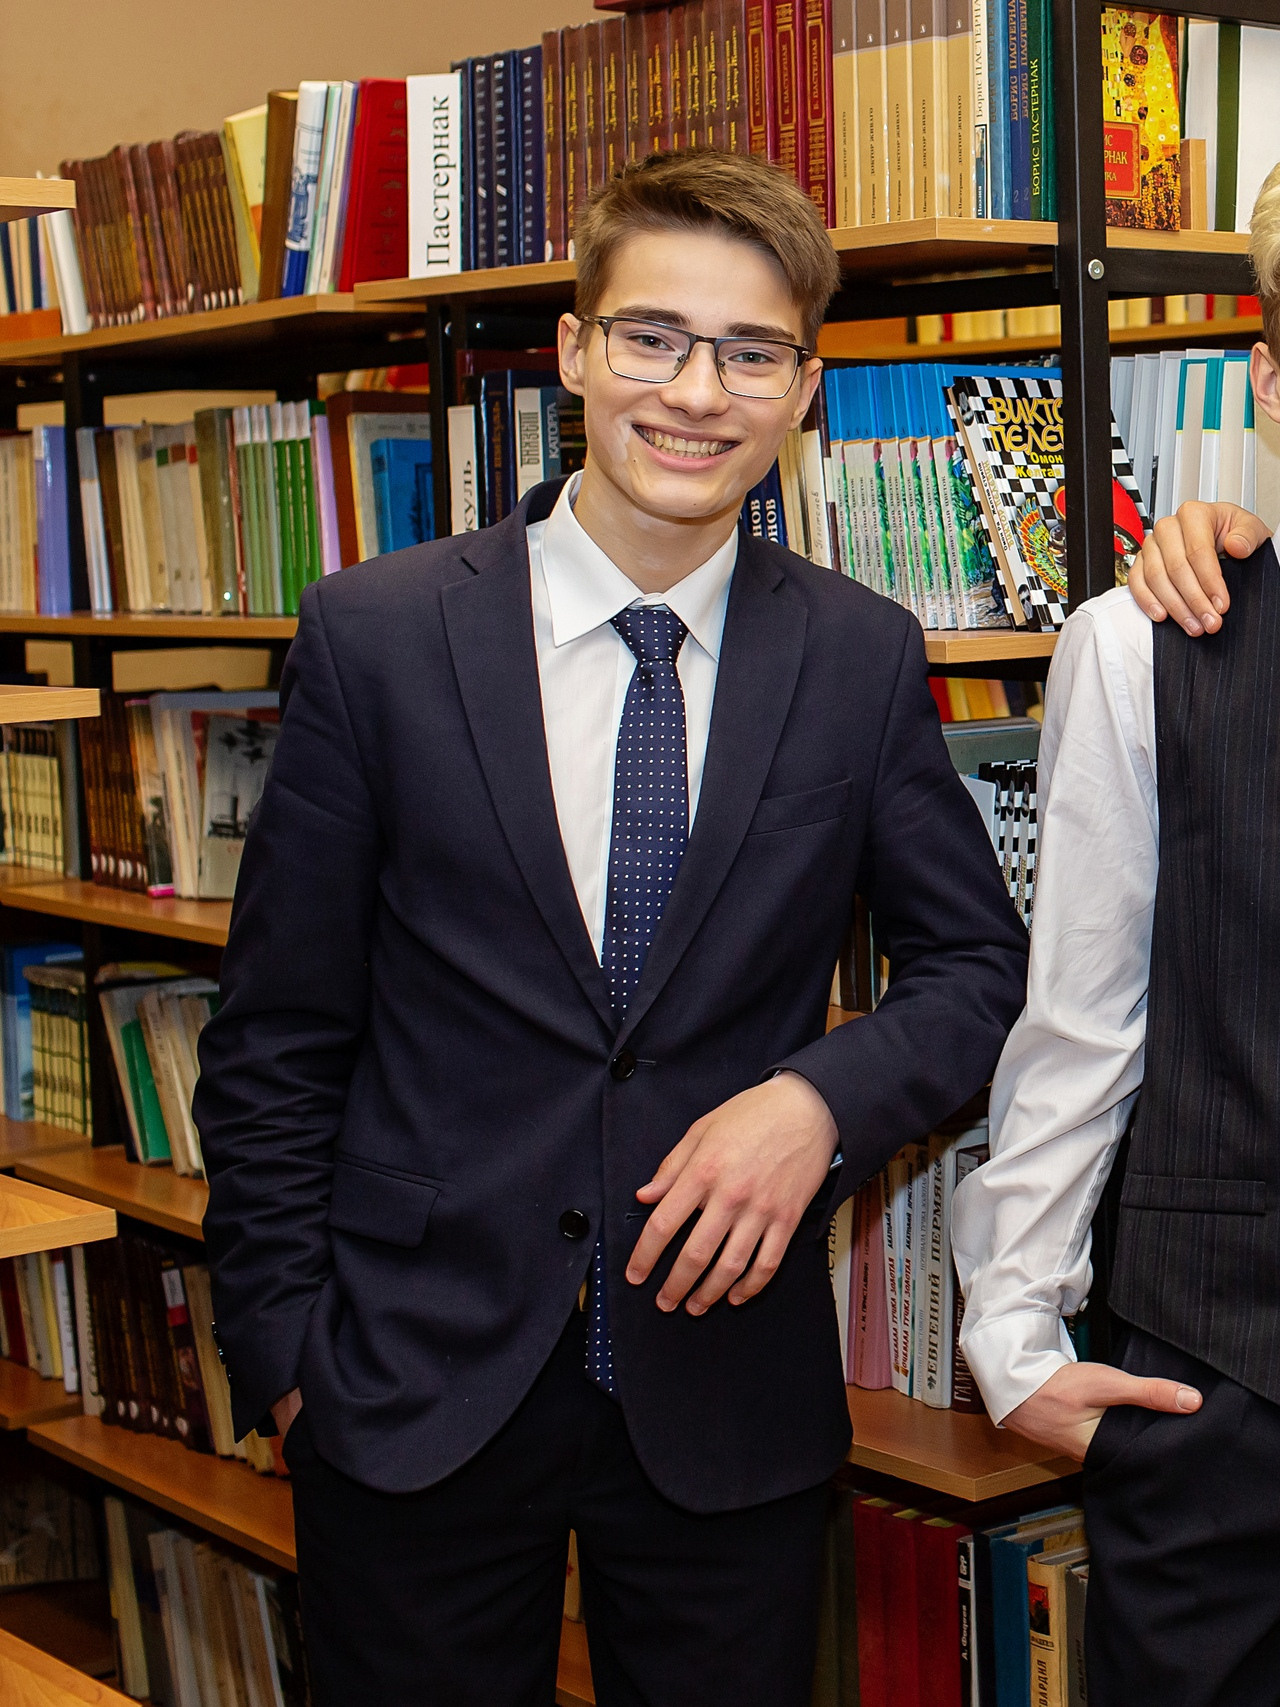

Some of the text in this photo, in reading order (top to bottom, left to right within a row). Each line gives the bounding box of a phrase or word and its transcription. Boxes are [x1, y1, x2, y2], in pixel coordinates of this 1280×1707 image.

[811, 38, 819, 98] ПАСТЕРНАК
[976, 79, 985, 118] Борис
[1010, 75, 1019, 121] БОРИС
[1020, 72, 1029, 118] БОРИС
[1030, 58, 1041, 196] БОРИС ПАСТЕРНАК
[426, 96, 456, 266] Пастернак
[546, 402, 560, 459] КАТОРГА
[977, 462, 988, 487] стрела
[983, 459, 1014, 547] ВИКТОР ПЕЛЕВИН
[985, 488, 997, 515] Желтая
[1000, 533, 1008, 551] Омон
[888, 1257, 897, 1296] ЗОЛОТАЯ
[903, 1258, 911, 1297] ЗОЛОТАЯ
[927, 1170, 943, 1375] ЕВГЕНИЙ ПЕРМЯК
[890, 1297, 898, 1324] ТУЧКА
[901, 1299, 910, 1327] ТУЧКА
[954, 1337, 972, 1402] ГАМАЮ
